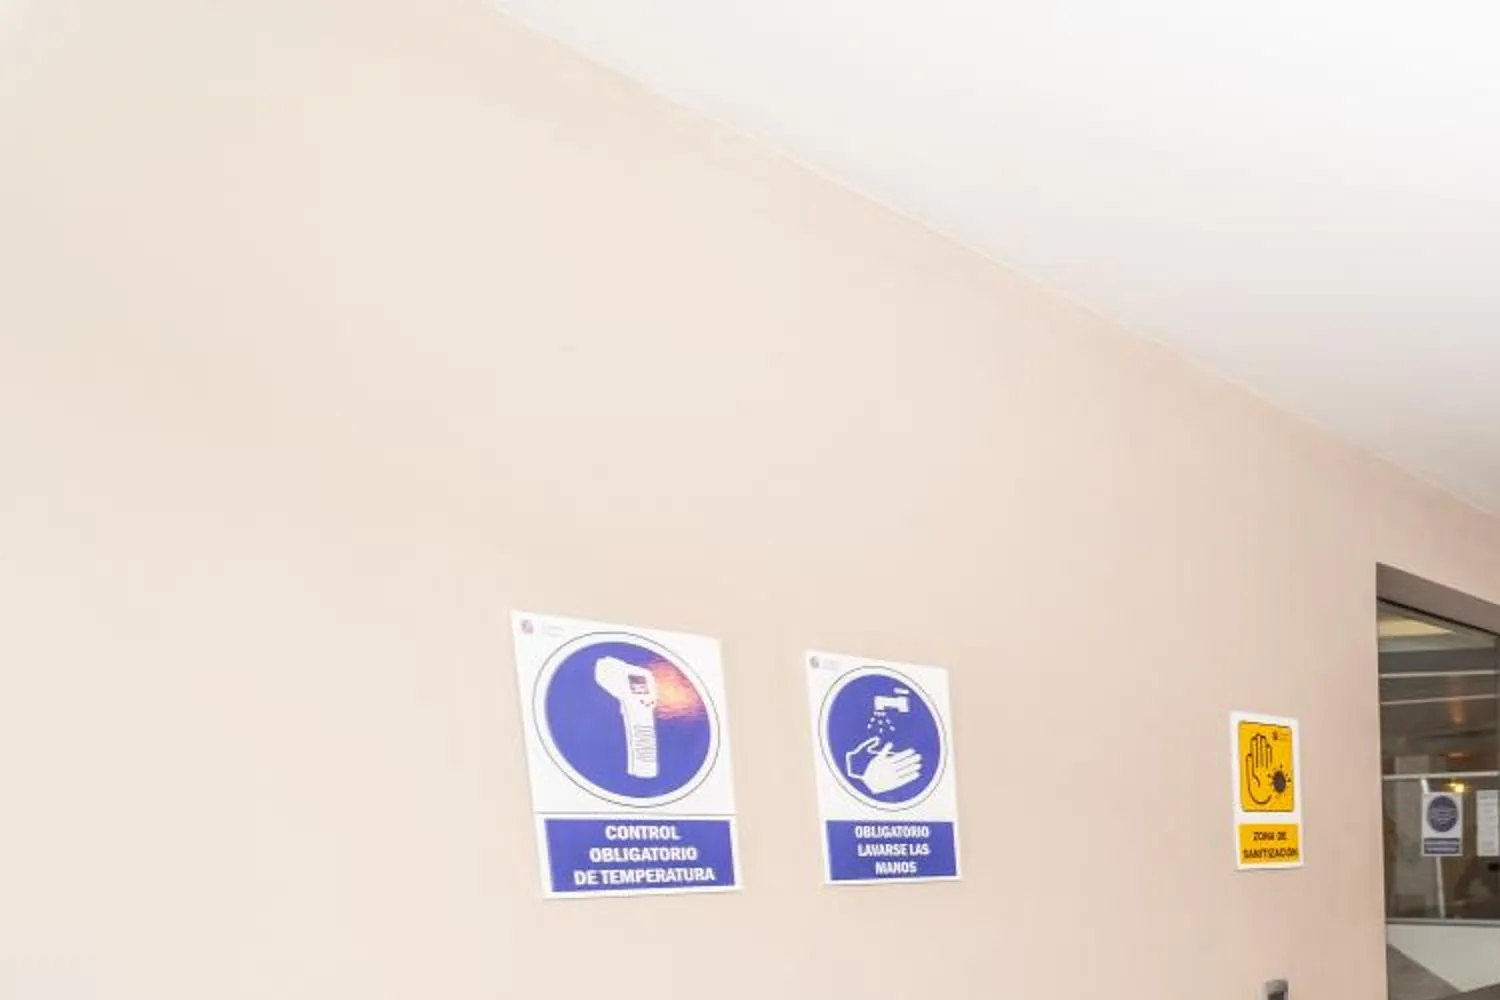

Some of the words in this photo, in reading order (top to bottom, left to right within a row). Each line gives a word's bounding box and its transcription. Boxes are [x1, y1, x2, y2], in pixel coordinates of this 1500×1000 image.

[605, 825, 682, 841] CONTROL
[854, 824, 930, 839] OBLIGATORIO
[589, 846, 698, 863] OBLIGATORIO
[857, 842, 908, 858] LAVARSE
[910, 842, 930, 856] LAS
[875, 860, 918, 876] MANOS
[573, 869, 599, 886] DE
[600, 867, 716, 885] TEMPERATURA
